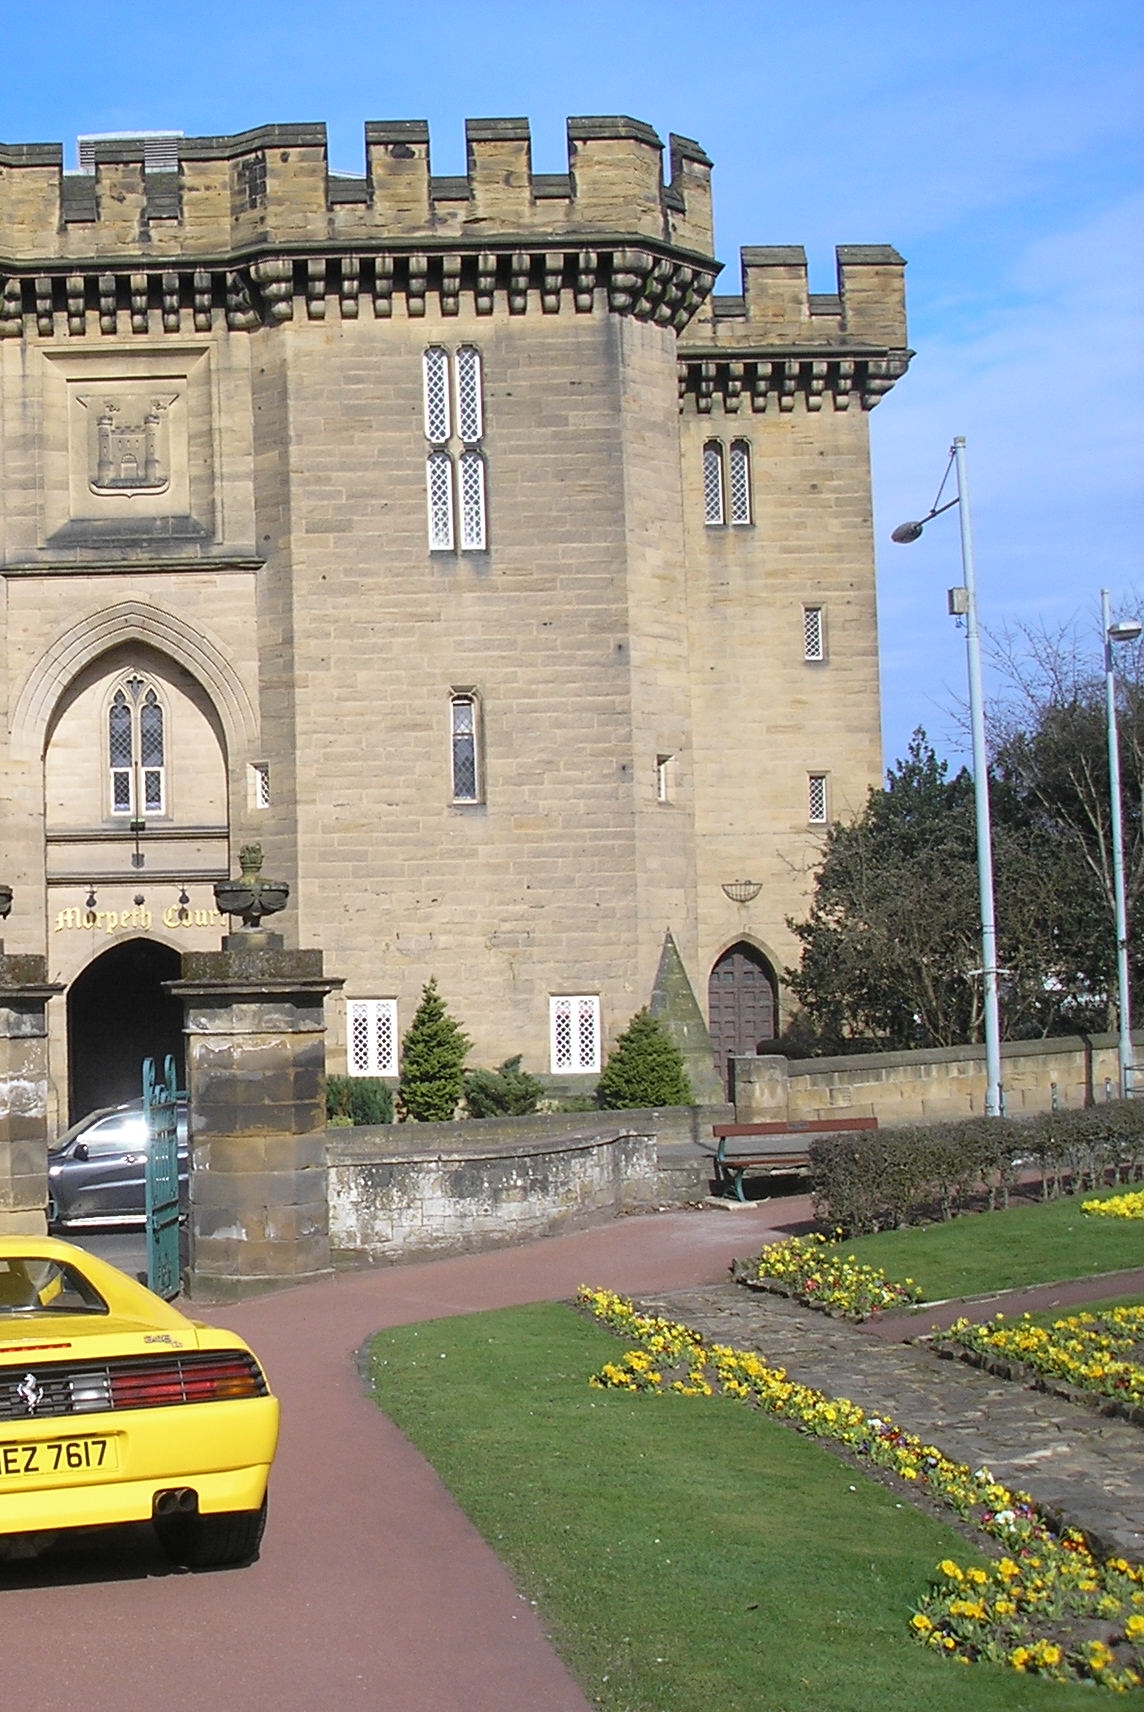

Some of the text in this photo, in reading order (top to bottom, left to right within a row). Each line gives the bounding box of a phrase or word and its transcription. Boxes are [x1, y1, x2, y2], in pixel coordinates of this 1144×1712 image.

[54, 905, 227, 934] Morpeth Court
[47, 1440, 107, 1470] 7617
